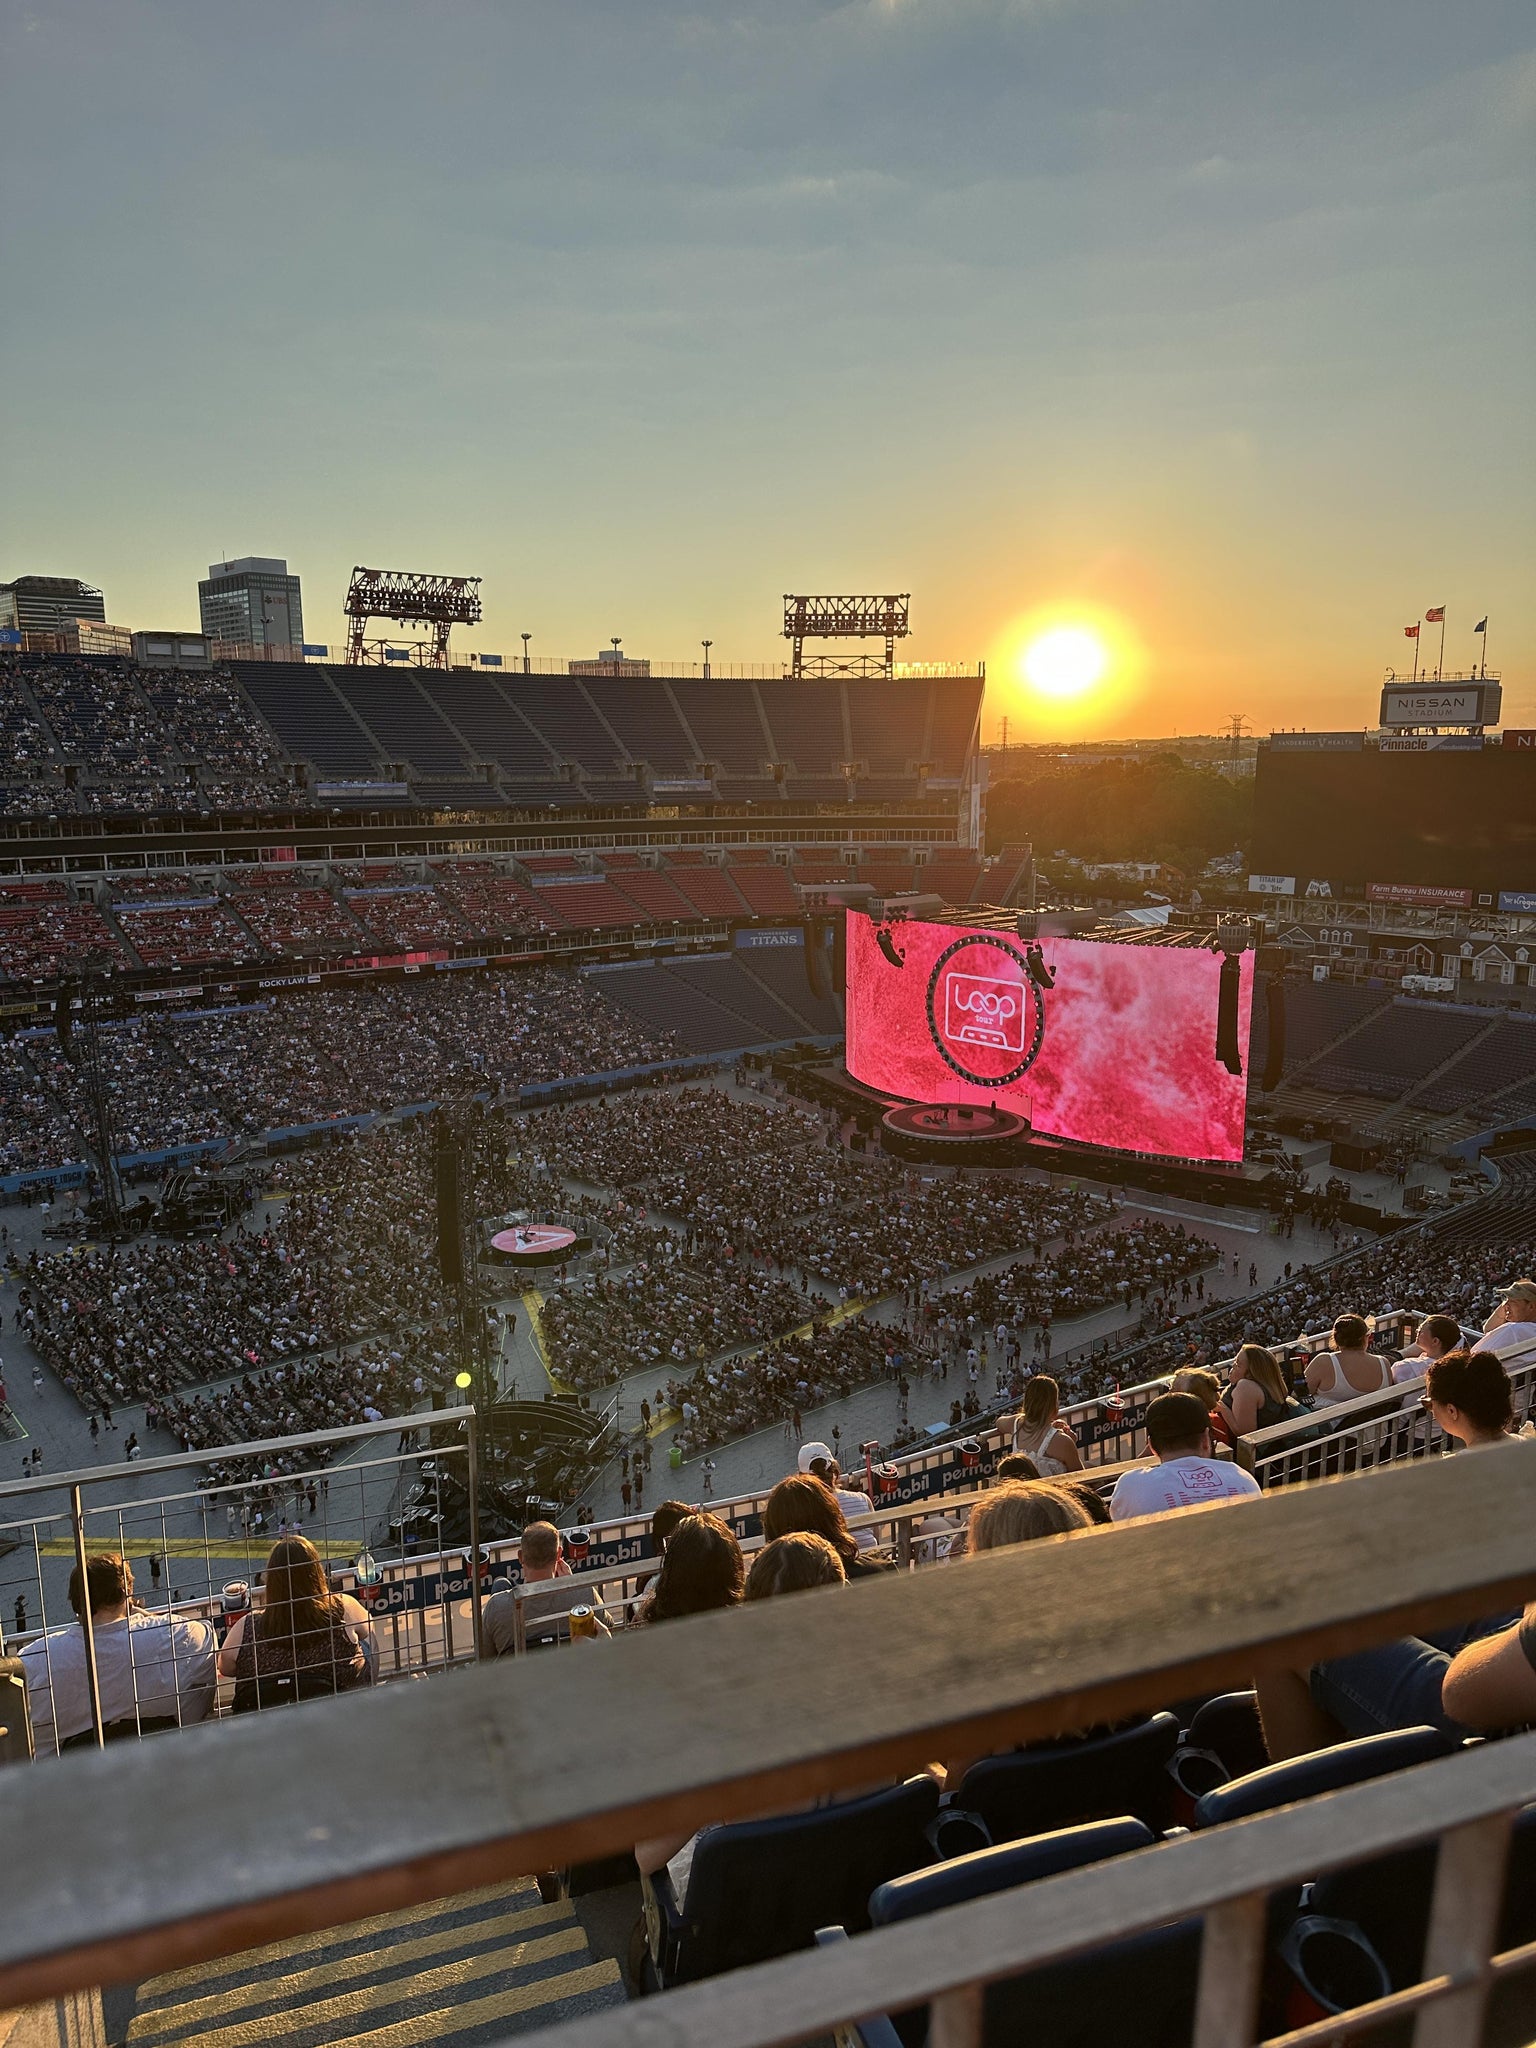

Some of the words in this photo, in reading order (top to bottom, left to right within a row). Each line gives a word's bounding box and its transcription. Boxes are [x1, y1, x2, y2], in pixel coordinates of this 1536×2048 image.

[1398, 698, 1465, 708] NISSAN
[1407, 709, 1453, 717] STADIUM
[1380, 738, 1428, 750] Pinnacle
[1371, 884, 1390, 893] Farm
[1391, 886, 1417, 895] Bureau
[1418, 887, 1466, 899] INSURANCE
[750, 935, 798, 945] TITANS
[259, 979, 286, 988] ROCKY
[287, 977, 305, 985] LAW
[219, 985, 240, 993] FedEx
[30, 1014, 54, 1023] MOON
[974, 1014, 995, 1025] tour
